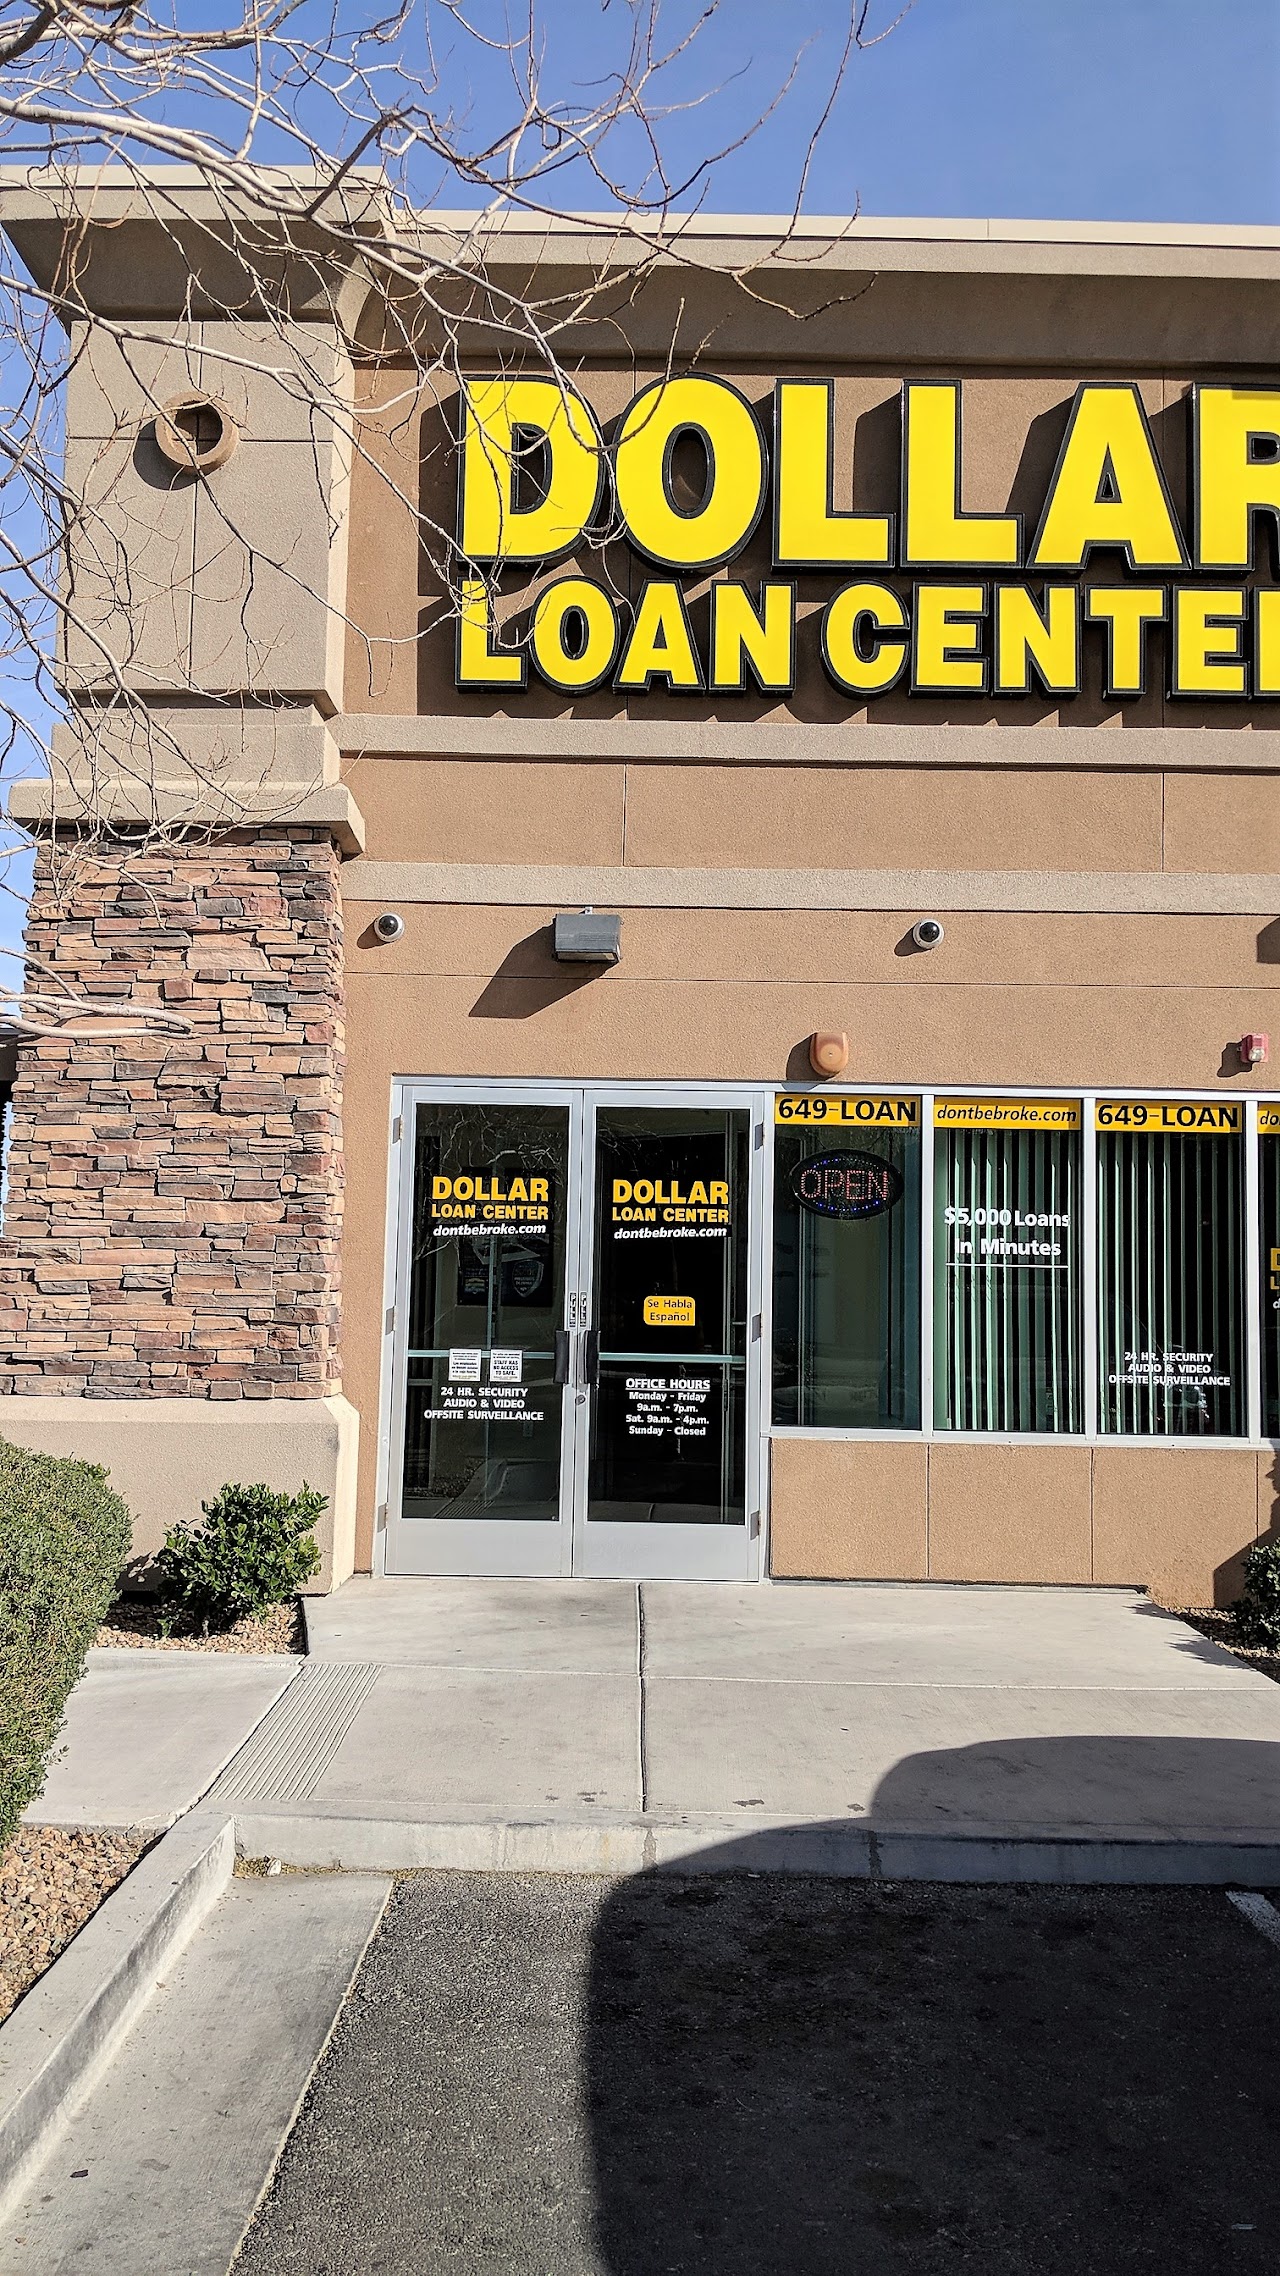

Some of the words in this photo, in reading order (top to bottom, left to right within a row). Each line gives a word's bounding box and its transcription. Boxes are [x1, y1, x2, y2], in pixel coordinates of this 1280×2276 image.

[455, 372, 1280, 577] DOLLAR
[455, 577, 798, 697] LOAN
[778, 1098, 917, 1121] 649-LOAN
[937, 1104, 1077, 1122] dontbebroke.com
[1098, 1104, 1238, 1128] 649-LOAN
[432, 1176, 549, 1202] DOLLAR
[800, 1169, 888, 1201] OPEN
[612, 1179, 729, 1205] DOLLAR
[431, 1204, 476, 1219] LOAN
[482, 1204, 549, 1220] CENTER
[612, 1207, 656, 1222] LOAN
[663, 1208, 729, 1223] CENTER
[944, 1206, 1012, 1226] $5,000
[1014, 1210, 1071, 1227] Loans
[433, 1223, 547, 1236] dontbebroke.com
[613, 1227, 727, 1239] dontbebroke.com
[955, 1238, 973, 1254] In
[980, 1238, 1061, 1256] Minutes
[647, 1299, 659, 1308] Se
[663, 1299, 693, 1309] Habla
[650, 1311, 690, 1323] Español
[1124, 1352, 1137, 1361] 24
[1140, 1352, 1160, 1361] HR.
[1162, 1352, 1214, 1363] SECURITY
[1127, 1364, 1162, 1373] AUDIO
[1178, 1364, 1212, 1374] VIDEO
[625, 1378, 666, 1389] OFFICE
[669, 1379, 711, 1390] HOURS
[1108, 1375, 1149, 1384] OFFSITE
[1153, 1375, 1231, 1386] SURVEILLANCE
[440, 1386, 454, 1396] 24
[457, 1386, 475, 1397] HR.
[478, 1387, 528, 1397] SECURITY
[628, 1391, 667, 1402] Monday
[677, 1392, 706, 1403] Friday
[443, 1398, 477, 1408] AUDIO
[480, 1399, 489, 1408] &
[493, 1399, 525, 1409] VIDEO
[636, 1403, 663, 1412] 9a.m.
[673, 1403, 699, 1413] 7p.m.
[423, 1409, 464, 1419] OFFSITE
[467, 1410, 544, 1421] SURVEILLANCE
[625, 1414, 644, 1423] Sat.
[646, 1414, 673, 1424] 9a.m.
[682, 1415, 710, 1425] 4p.m.
[628, 1425, 664, 1437] Sunday
[673, 1426, 707, 1436] Closed
